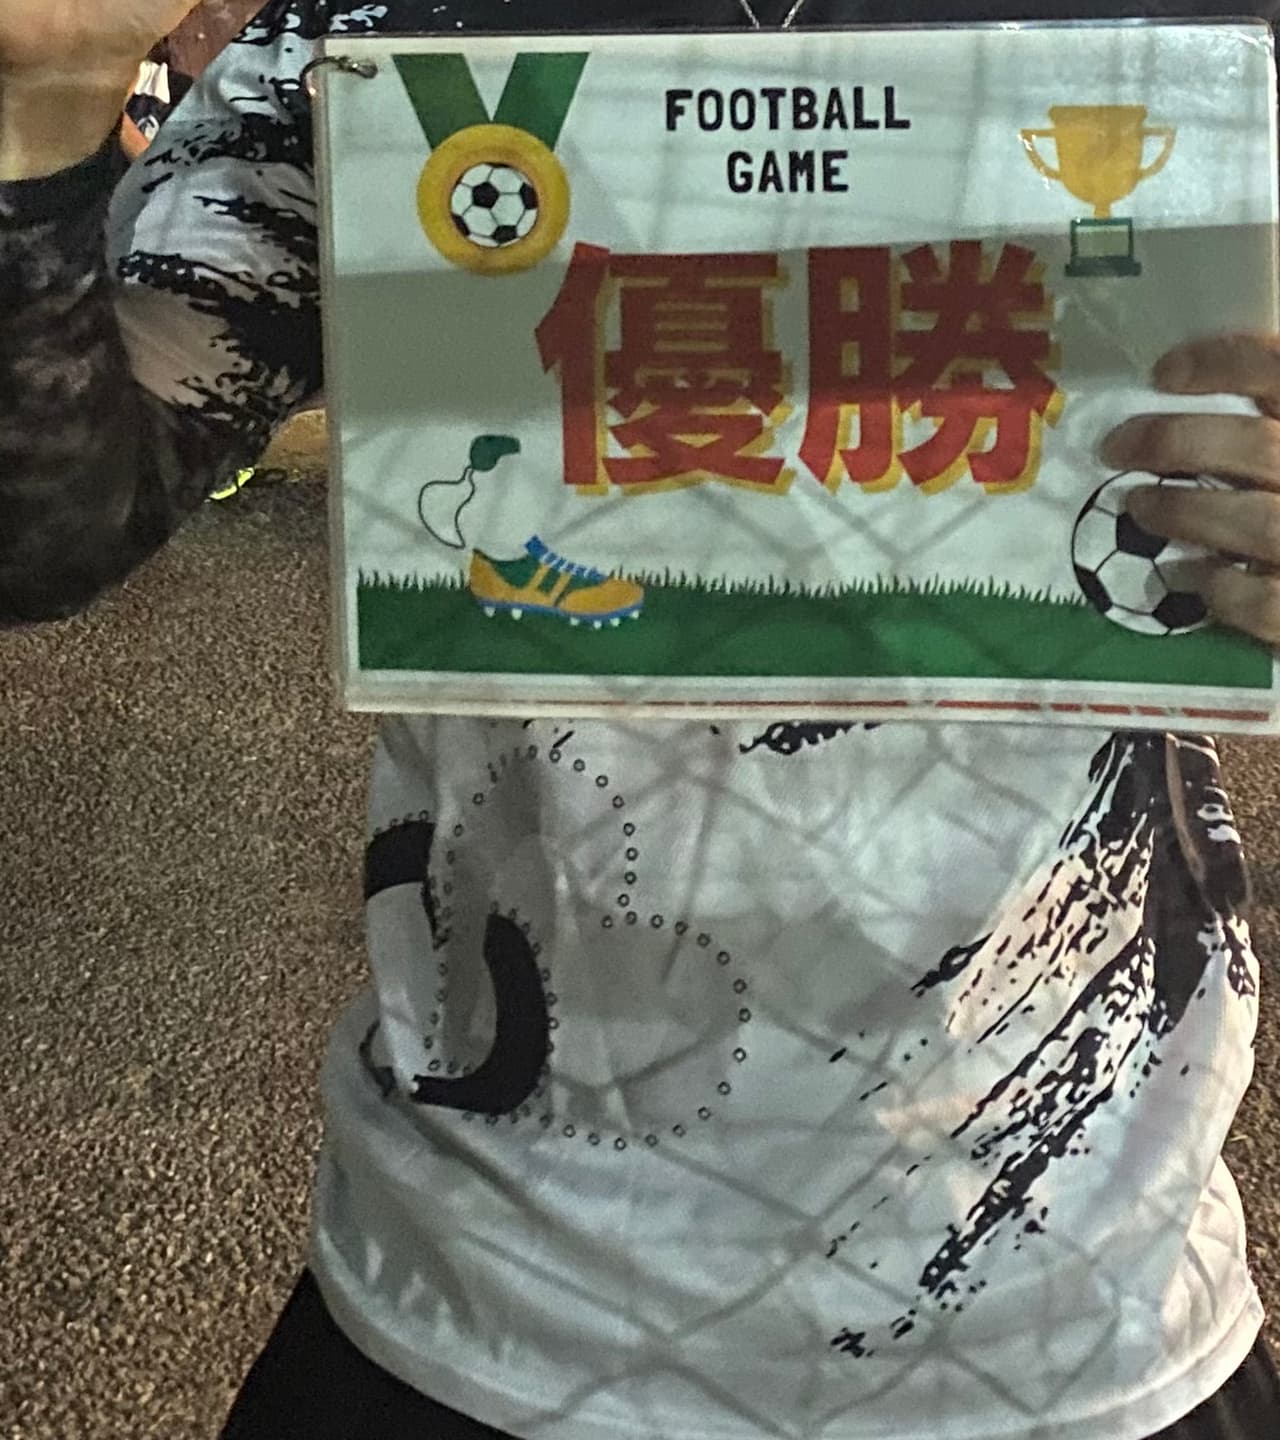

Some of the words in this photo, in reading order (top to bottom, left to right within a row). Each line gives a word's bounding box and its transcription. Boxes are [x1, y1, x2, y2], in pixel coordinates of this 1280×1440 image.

[665, 86, 911, 131] FOOTBALL
[727, 150, 849, 193] GAME
[533, 242, 1063, 495] 優勝
